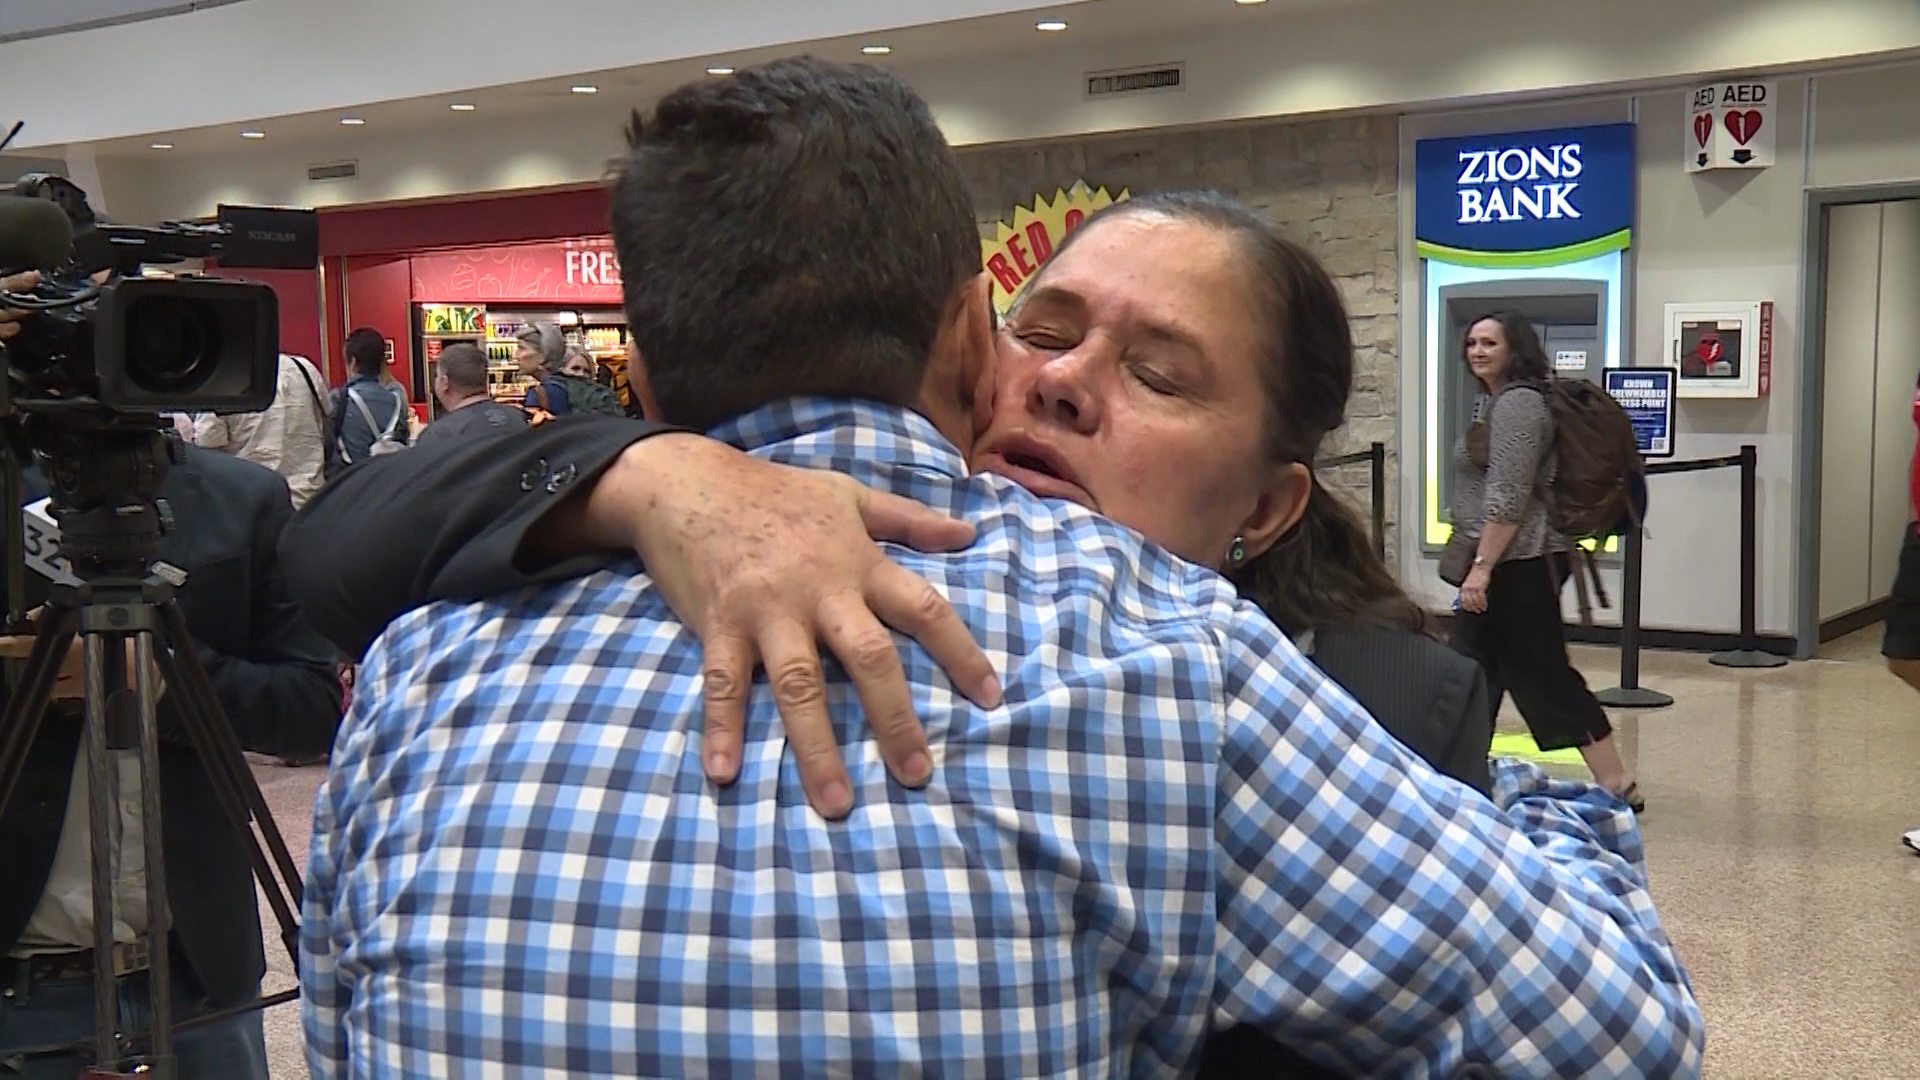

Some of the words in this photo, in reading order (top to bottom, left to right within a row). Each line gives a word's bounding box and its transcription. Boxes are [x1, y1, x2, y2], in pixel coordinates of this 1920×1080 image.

[1694, 87, 1715, 107] AED
[1722, 85, 1766, 102] AED
[1458, 143, 1582, 184] ZIONS
[1457, 183, 1581, 223] BANK
[986, 221, 1053, 294] RED
[1761, 305, 1770, 355] AED
[1610, 389, 1667, 398] CREWMEMBER
[1623, 379, 1654, 388] KNOWN
[1616, 399, 1641, 408] CCESS
[1642, 399, 1666, 408] POINT
[25, 524, 64, 570] 32
